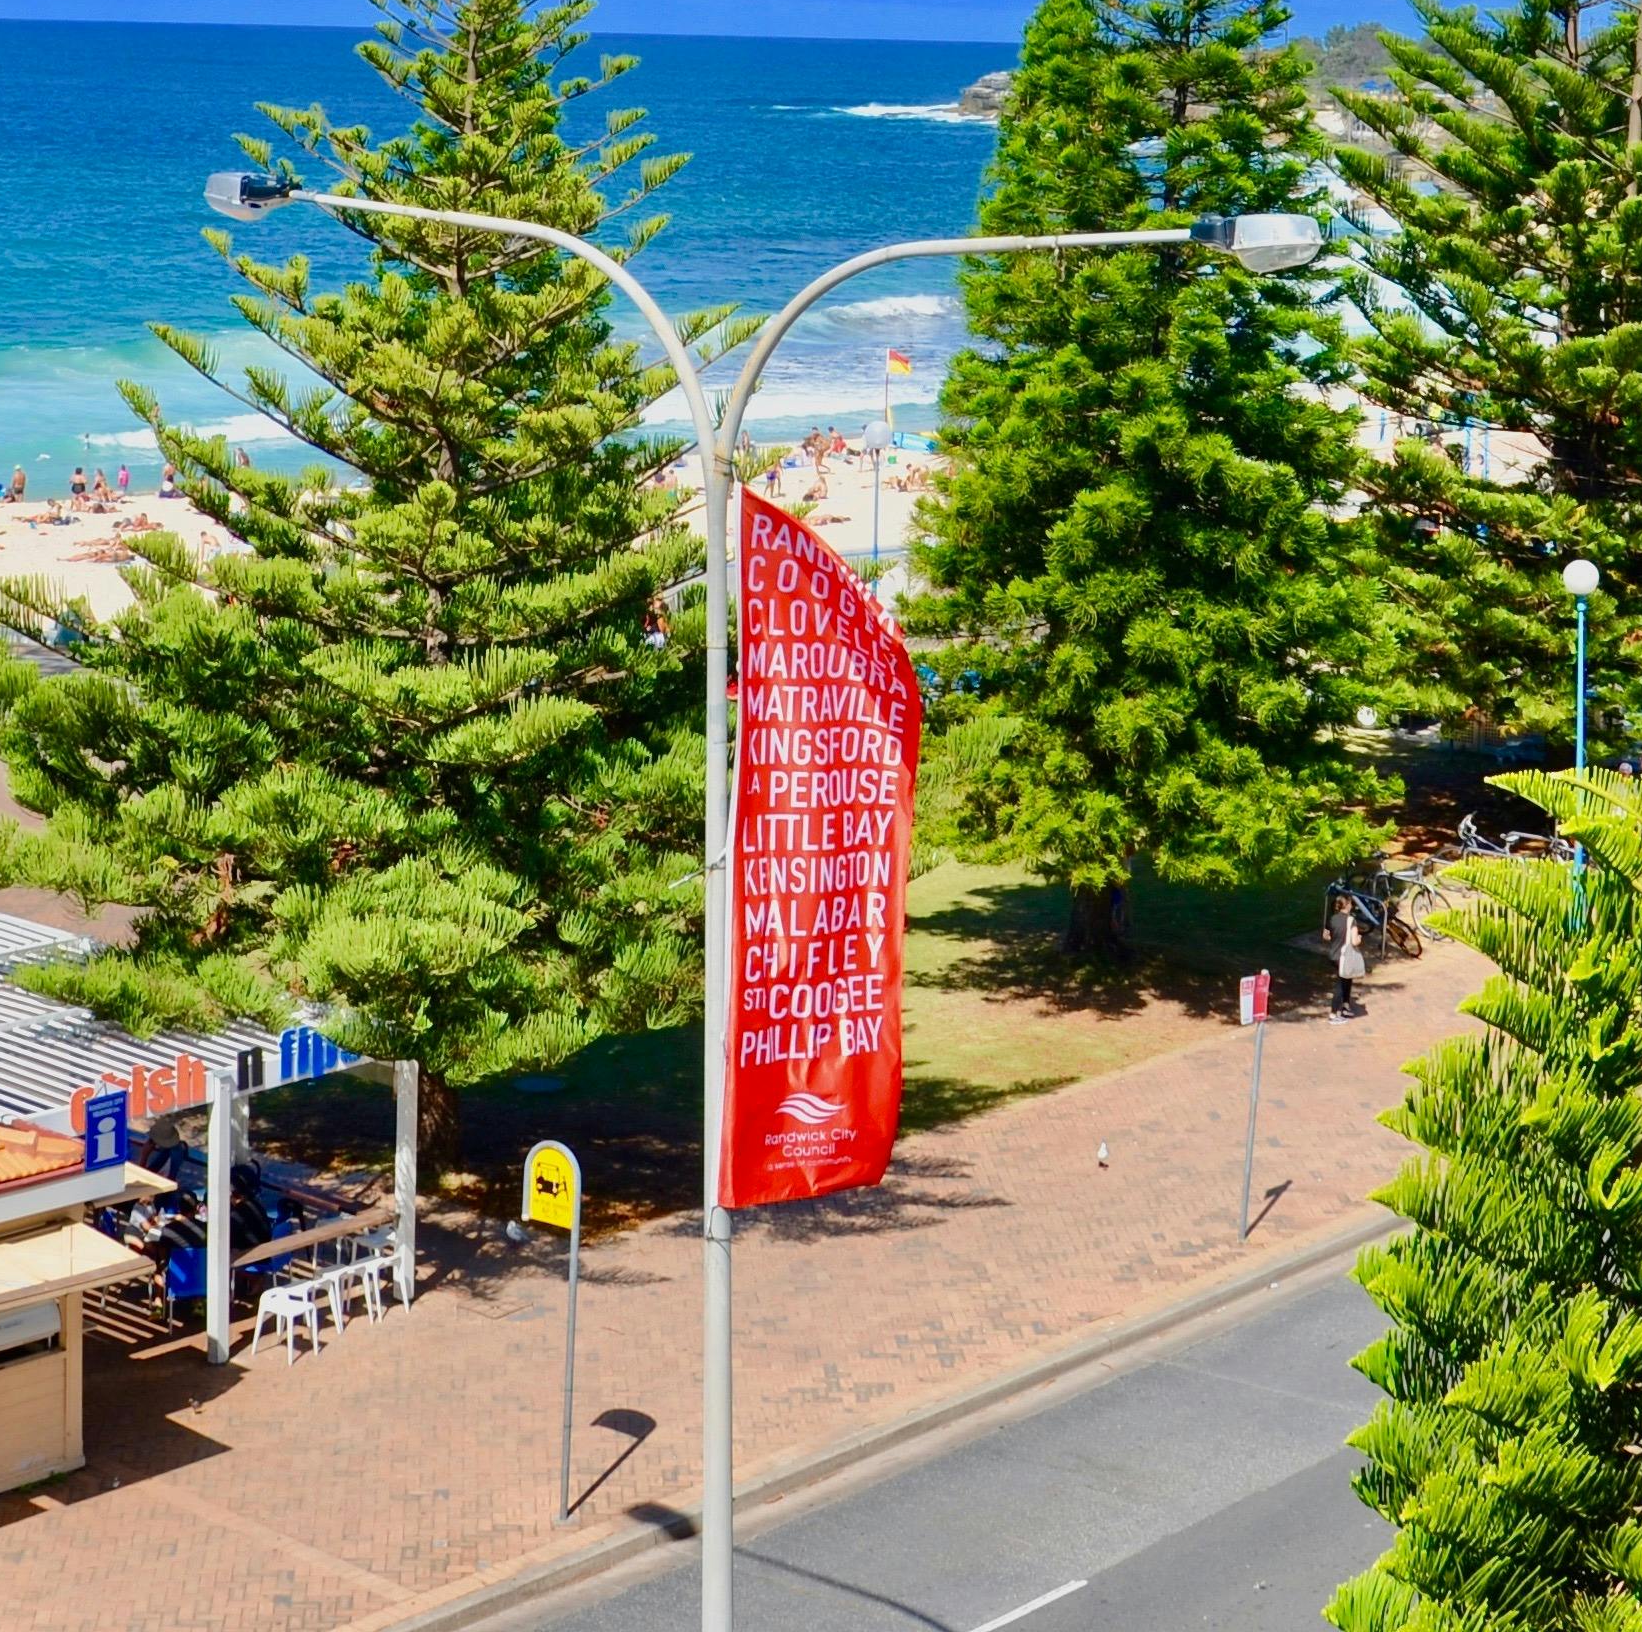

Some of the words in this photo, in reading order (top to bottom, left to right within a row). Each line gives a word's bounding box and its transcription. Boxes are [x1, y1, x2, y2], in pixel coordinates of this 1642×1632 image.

[747, 598, 898, 676] CLOVELLY
[747, 642, 908, 700] MAROUBRA
[747, 685, 907, 734] MATRAVILLE
[747, 727, 902, 767] KINGSFORD
[747, 778, 761, 795] LA
[769, 770, 900, 809] PEROUSE
[742, 813, 835, 854] LITTLE
[842, 810, 895, 849] BAY
[744, 851, 891, 897] KENSINGTON
[745, 891, 886, 941] MALABAR
[745, 933, 885, 984] CHIFLEY
[768, 973, 885, 1020] COOGEE
[740, 1023, 831, 1068] PHILLIP
[839, 1015, 884, 1058] BAY
[764, 1130, 827, 1147] Randwick
[830, 1127, 858, 1142] City
[782, 1142, 836, 1158] Council
